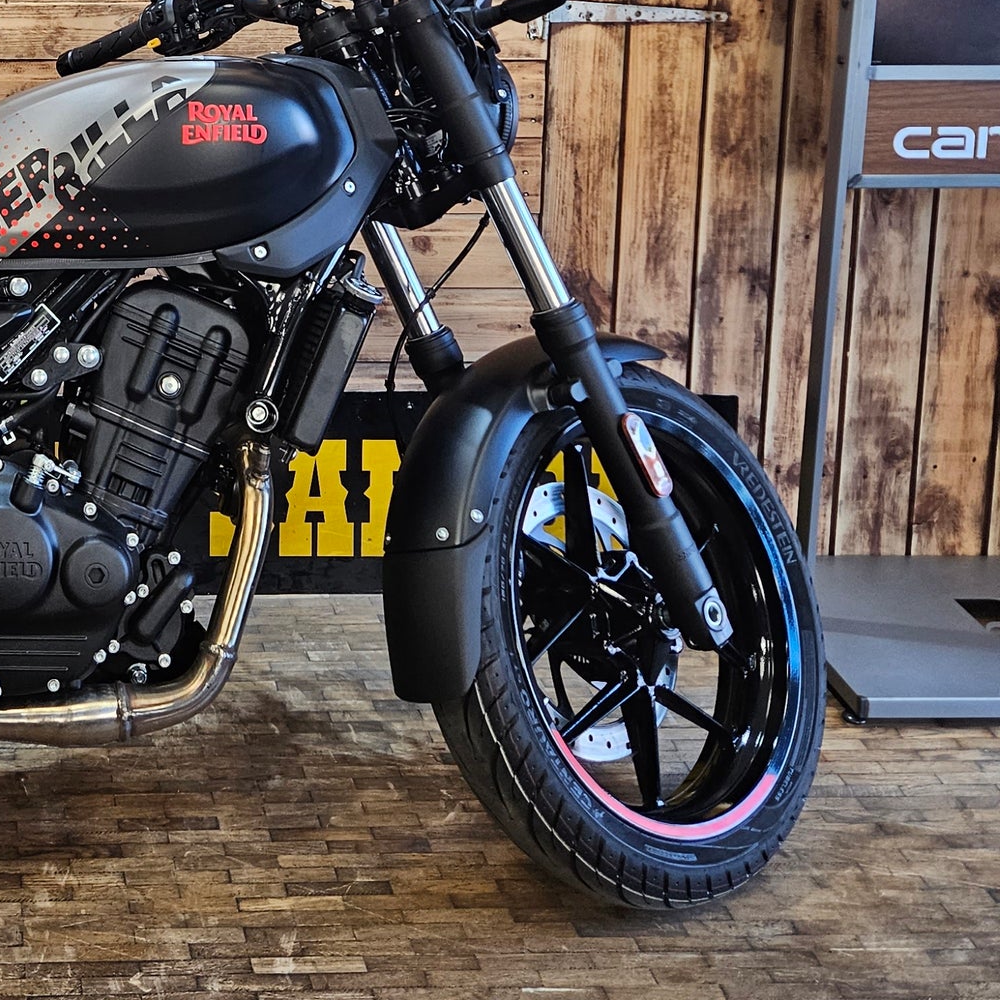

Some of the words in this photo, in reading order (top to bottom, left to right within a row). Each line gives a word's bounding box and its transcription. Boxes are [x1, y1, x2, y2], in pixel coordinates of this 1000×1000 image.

[182, 123, 268, 146] ENFIELD
[188, 101, 258, 125] ROYAL
[732, 451, 798, 564] VREDESTEIN
[519, 688, 594, 811] CENTAURO
